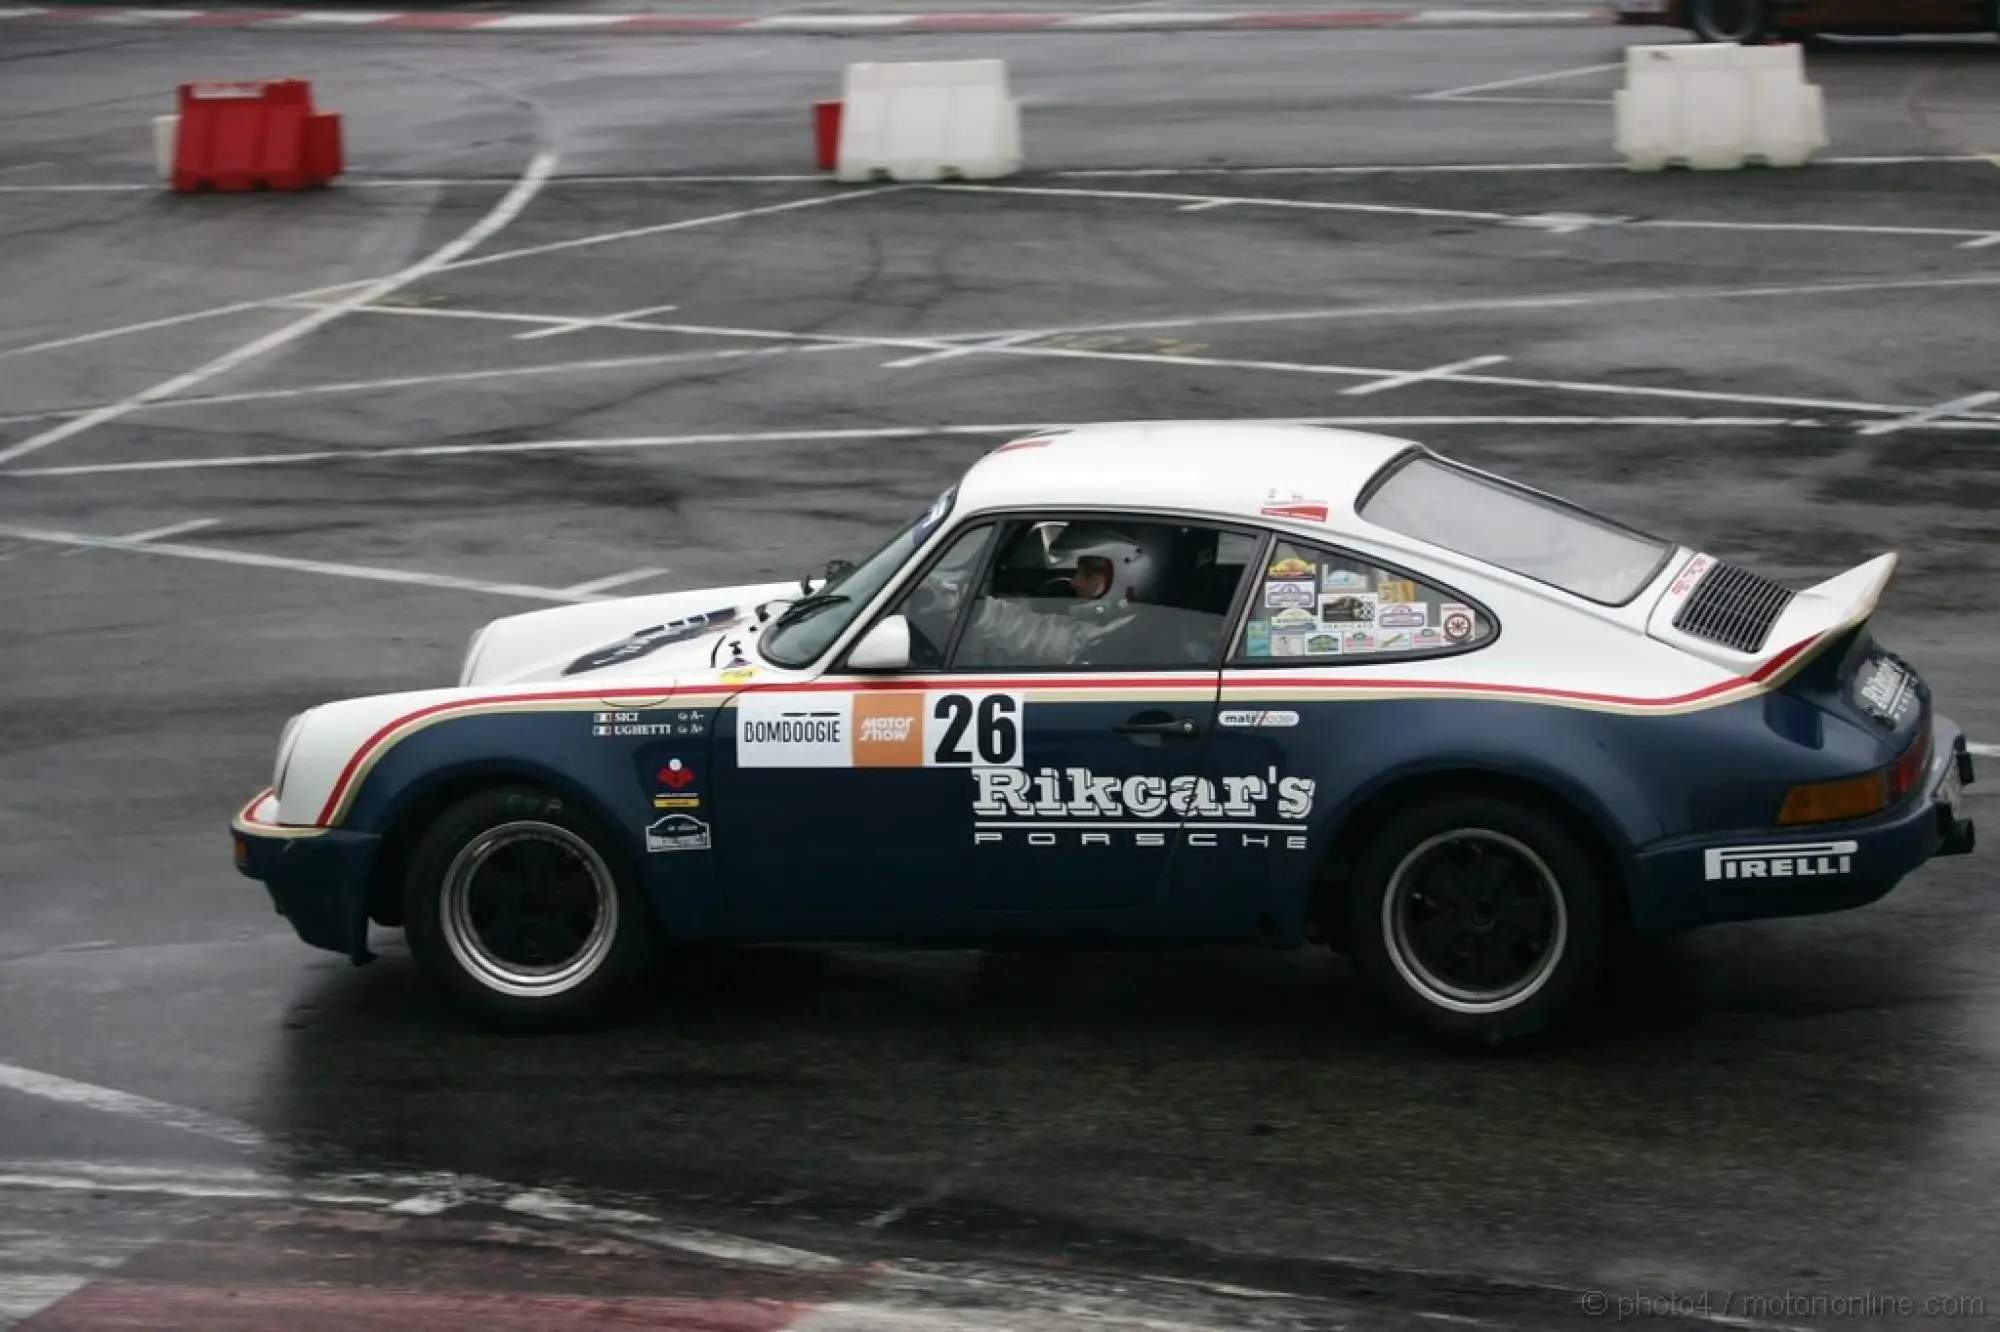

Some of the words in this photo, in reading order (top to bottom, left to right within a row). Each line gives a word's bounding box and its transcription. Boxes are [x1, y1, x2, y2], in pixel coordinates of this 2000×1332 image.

[614, 724, 671, 735] UGHETTI
[744, 720, 841, 743] BOMBOOGIE
[934, 693, 1017, 764] 26
[972, 766, 1315, 818] Rikcar's
[974, 832, 1308, 850] PORSCHE
[1705, 840, 1859, 880] PIRELLI
